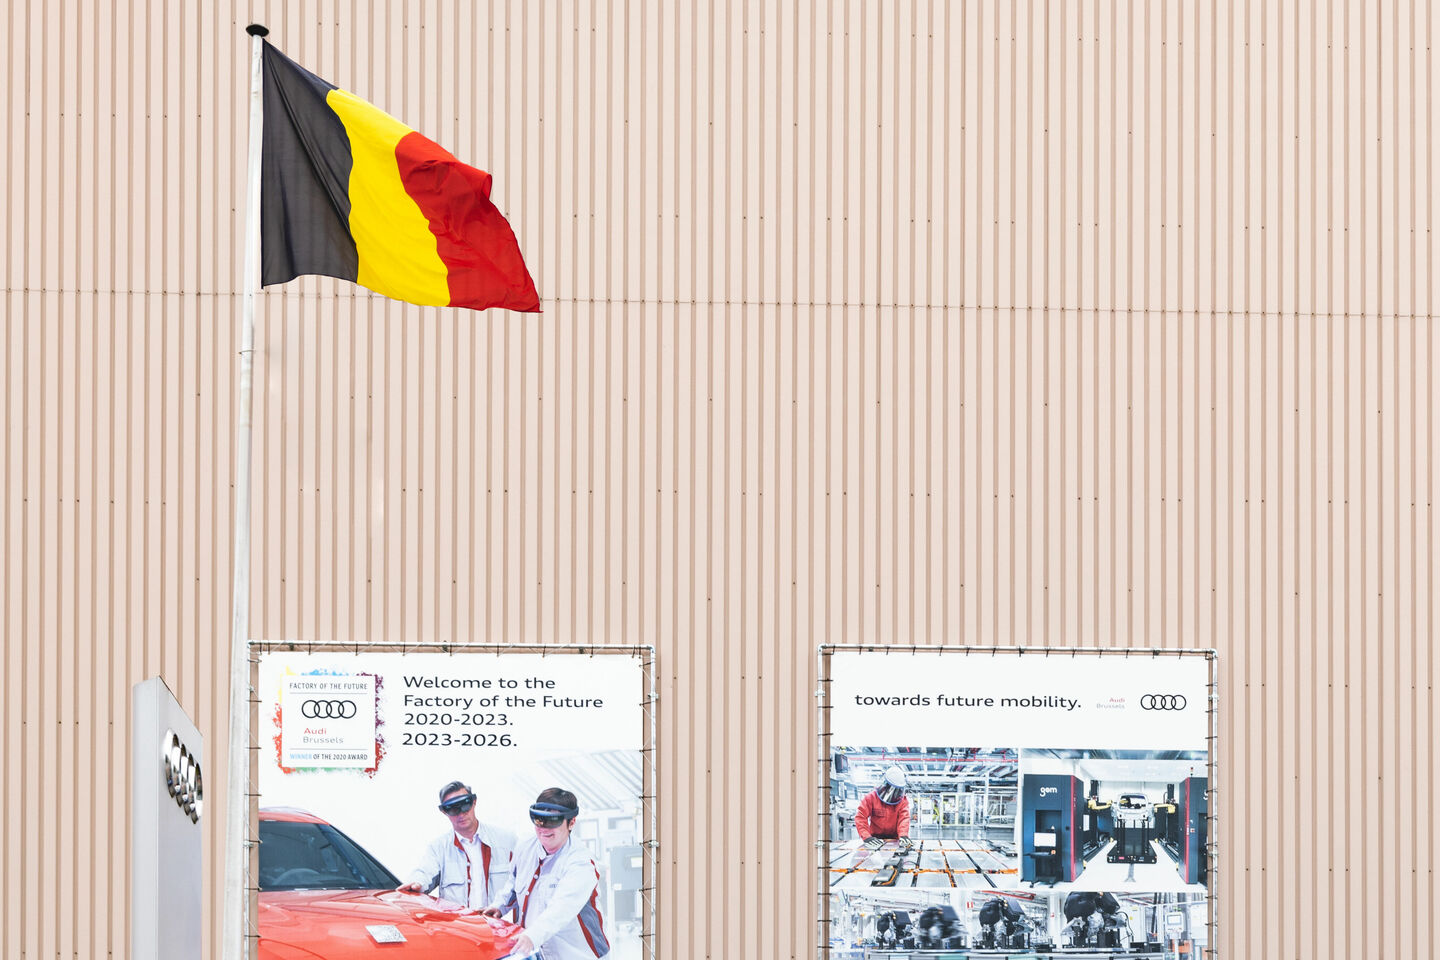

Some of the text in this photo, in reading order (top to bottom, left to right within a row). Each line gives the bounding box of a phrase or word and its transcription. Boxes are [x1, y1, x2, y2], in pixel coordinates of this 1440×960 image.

[289, 682, 368, 691] FACTORY OF THE FUTURE
[403, 675, 556, 690] Welcome to the
[404, 694, 604, 711] Factory of the Future
[854, 693, 1082, 712] towards future mobility.
[404, 712, 514, 727] 2020-2023.
[303, 727, 327, 735] Audi
[302, 736, 344, 744] Brussels
[402, 732, 519, 748] 2023-2026.
[321, 753, 332, 761] THE
[333, 753, 347, 761] 2020
[347, 753, 368, 761] AWARD
[1039, 786, 1058, 798] gom
